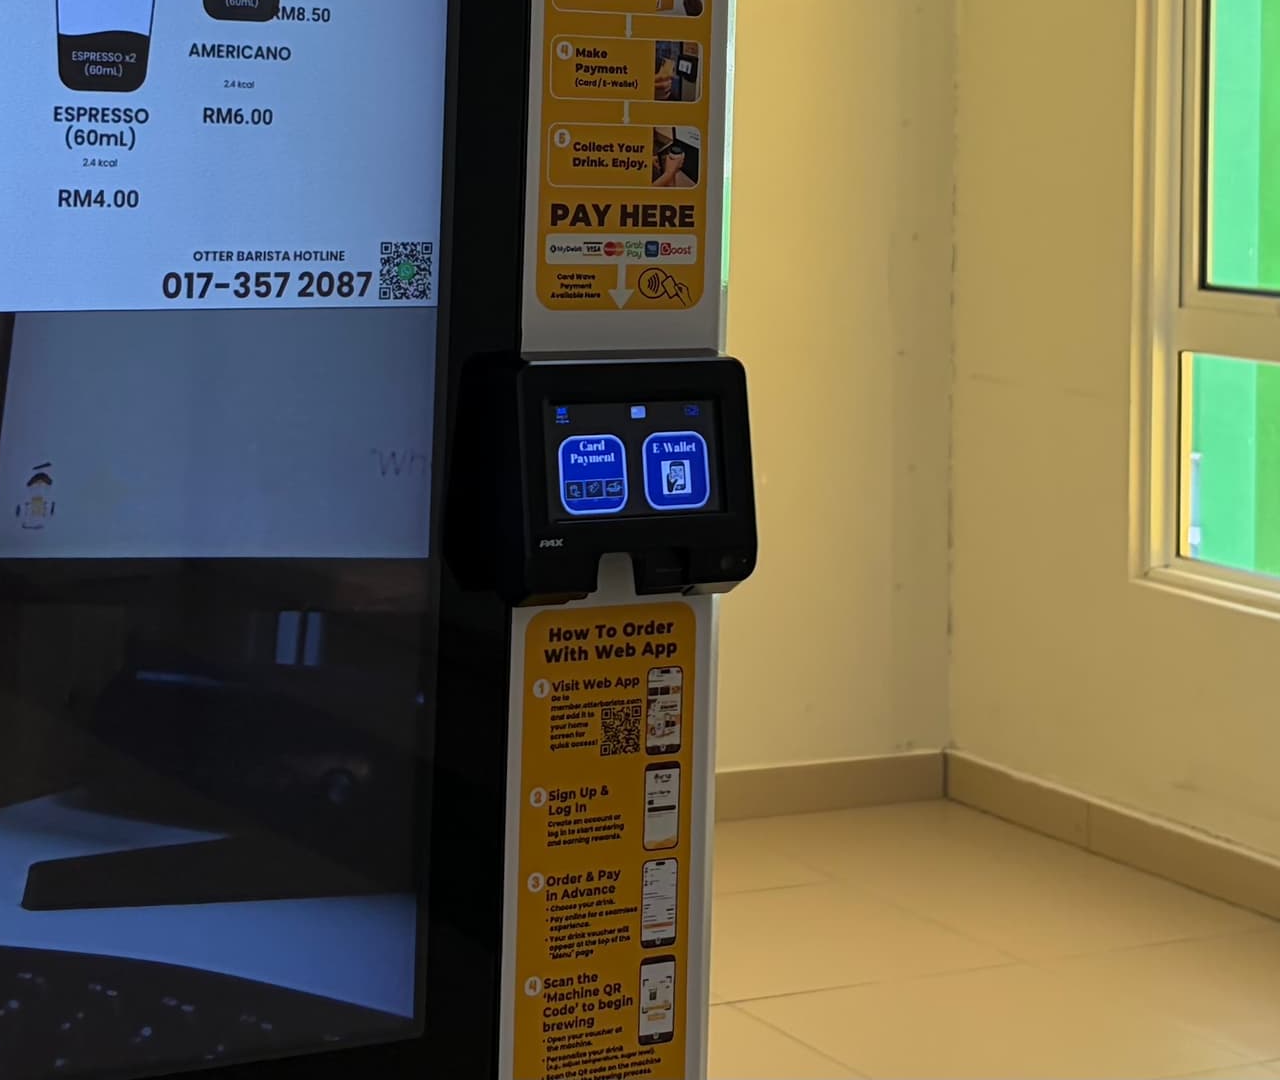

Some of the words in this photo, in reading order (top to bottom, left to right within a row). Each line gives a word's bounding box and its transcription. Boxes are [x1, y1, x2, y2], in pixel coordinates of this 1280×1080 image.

[272, 6, 331, 23] RM8.50
[71, 51, 122, 62] ESPRESSO
[124, 53, 137, 63] x2
[189, 43, 291, 61] AMERICANO
[575, 47, 608, 59] Make
[84, 64, 123, 77] (60mL)
[575, 63, 628, 75] Payment
[53, 106, 149, 124] ESPRESSO
[203, 107, 273, 125] RM6.00
[64, 126, 137, 151] (60mL)
[573, 141, 614, 152] Collect
[617, 142, 645, 153] Your
[572, 157, 609, 168] Drink.
[611, 158, 648, 170] Enjoy.
[57, 189, 139, 208] RM4.00
[550, 203, 612, 227] PAY
[619, 204, 695, 228] HERE
[193, 250, 234, 262] OTTER
[236, 250, 291, 262] BARISTA
[293, 250, 345, 262] HOTLINE
[162, 271, 291, 299] 017-357
[297, 271, 373, 298] 2087
[579, 439, 605, 452] Card
[652, 441, 697, 454] E-Wallet
[570, 452, 615, 466] Payment
[549, 626, 590, 643] How
[595, 624, 617, 639] To
[622, 620, 674, 637] Order
[544, 646, 588, 663] With
[595, 644, 636, 659] Web
[641, 641, 677, 659] App
[552, 680, 579, 692] Visit
[583, 677, 612, 690] Web
[614, 676, 640, 689] App
[548, 789, 576, 802] Sign
[580, 787, 597, 799] Up
[601, 785, 609, 796] &
[548, 804, 571, 816] Log
[575, 803, 587, 813] In
[546, 873, 582, 887] Order
[586, 871, 594, 882] &
[598, 869, 621, 881] Pay
[545, 889, 558, 901] in
[561, 884, 616, 900] Advance
[543, 977, 574, 989] Scan
[577, 972, 598, 984] the
[543, 1016, 595, 1033] brewing
